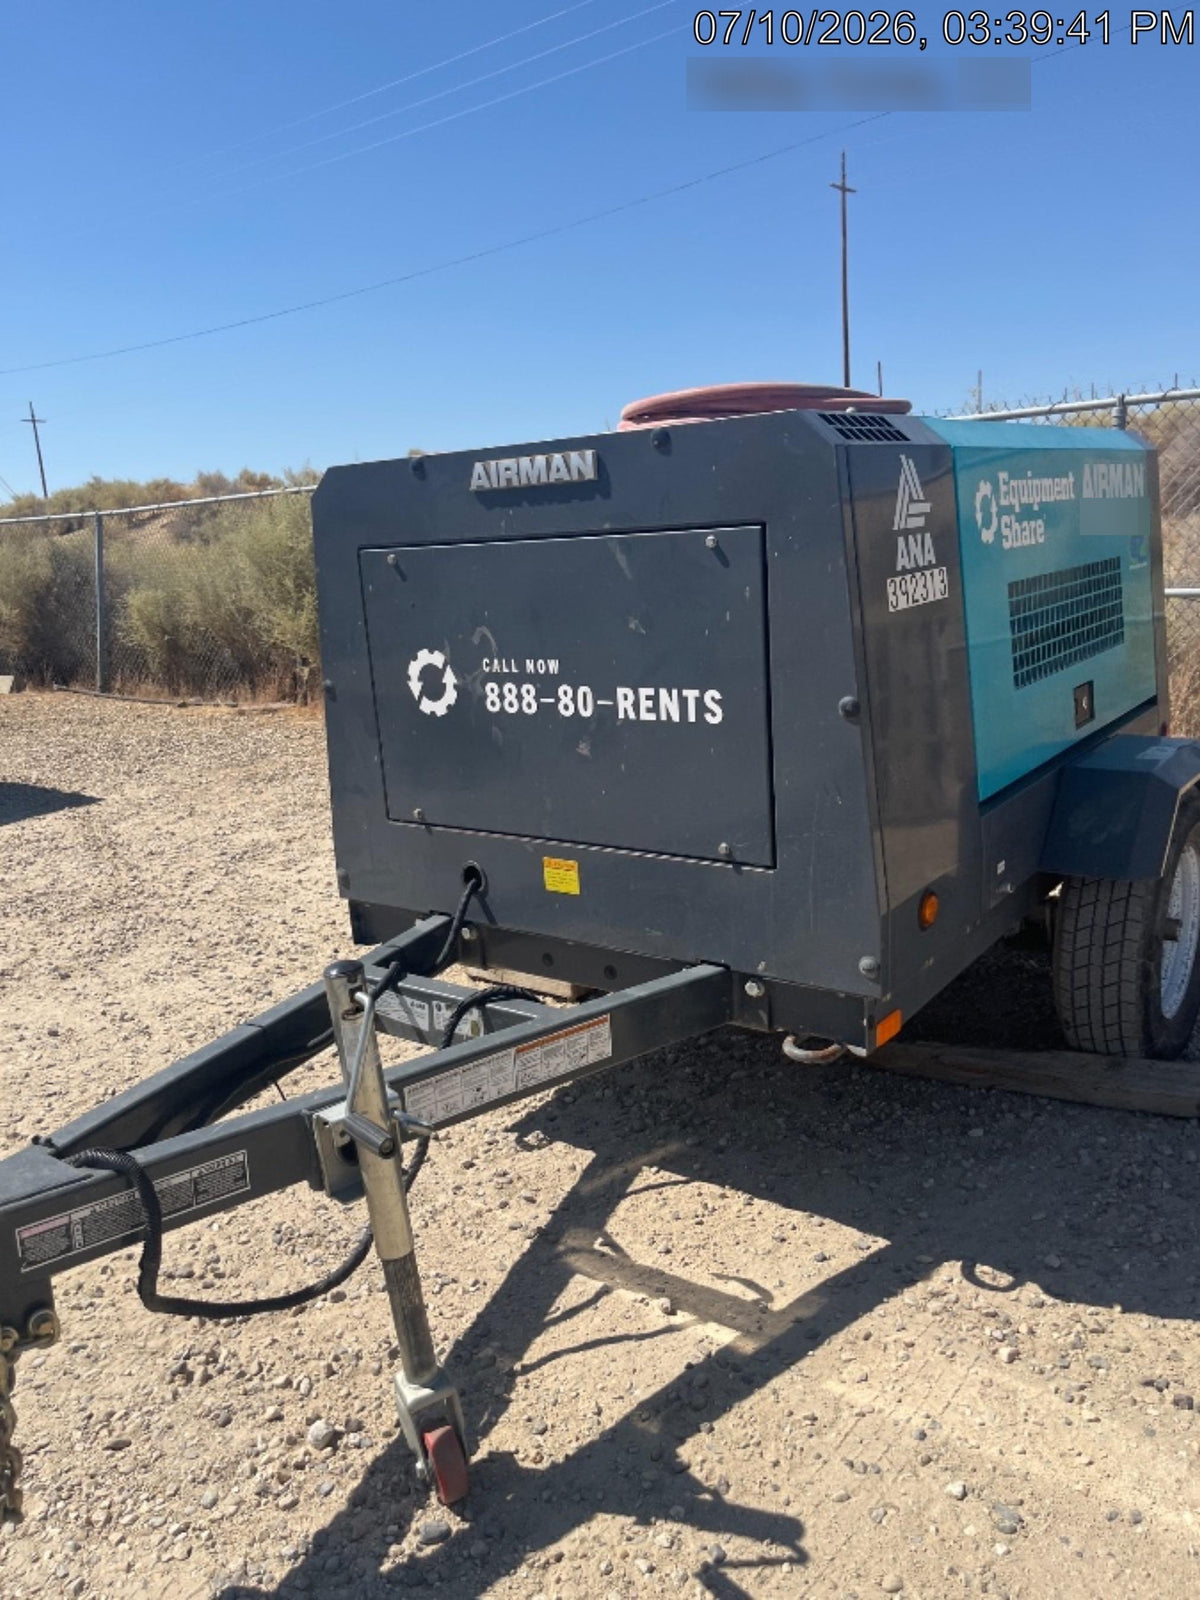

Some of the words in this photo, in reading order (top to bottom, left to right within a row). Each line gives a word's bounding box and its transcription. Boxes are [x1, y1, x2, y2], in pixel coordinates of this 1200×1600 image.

[469, 449, 598, 492] AIRMAN
[1082, 463, 1144, 498] AIRMAN
[998, 470, 1075, 512] Equipment
[1001, 513, 1045, 549] Share
[896, 532, 936, 571] ANA
[889, 568, 947, 609] 392313
[482, 658, 519, 673] CALL
[525, 659, 560, 674] NOW
[484, 682, 723, 725] 888-80-RENTS
